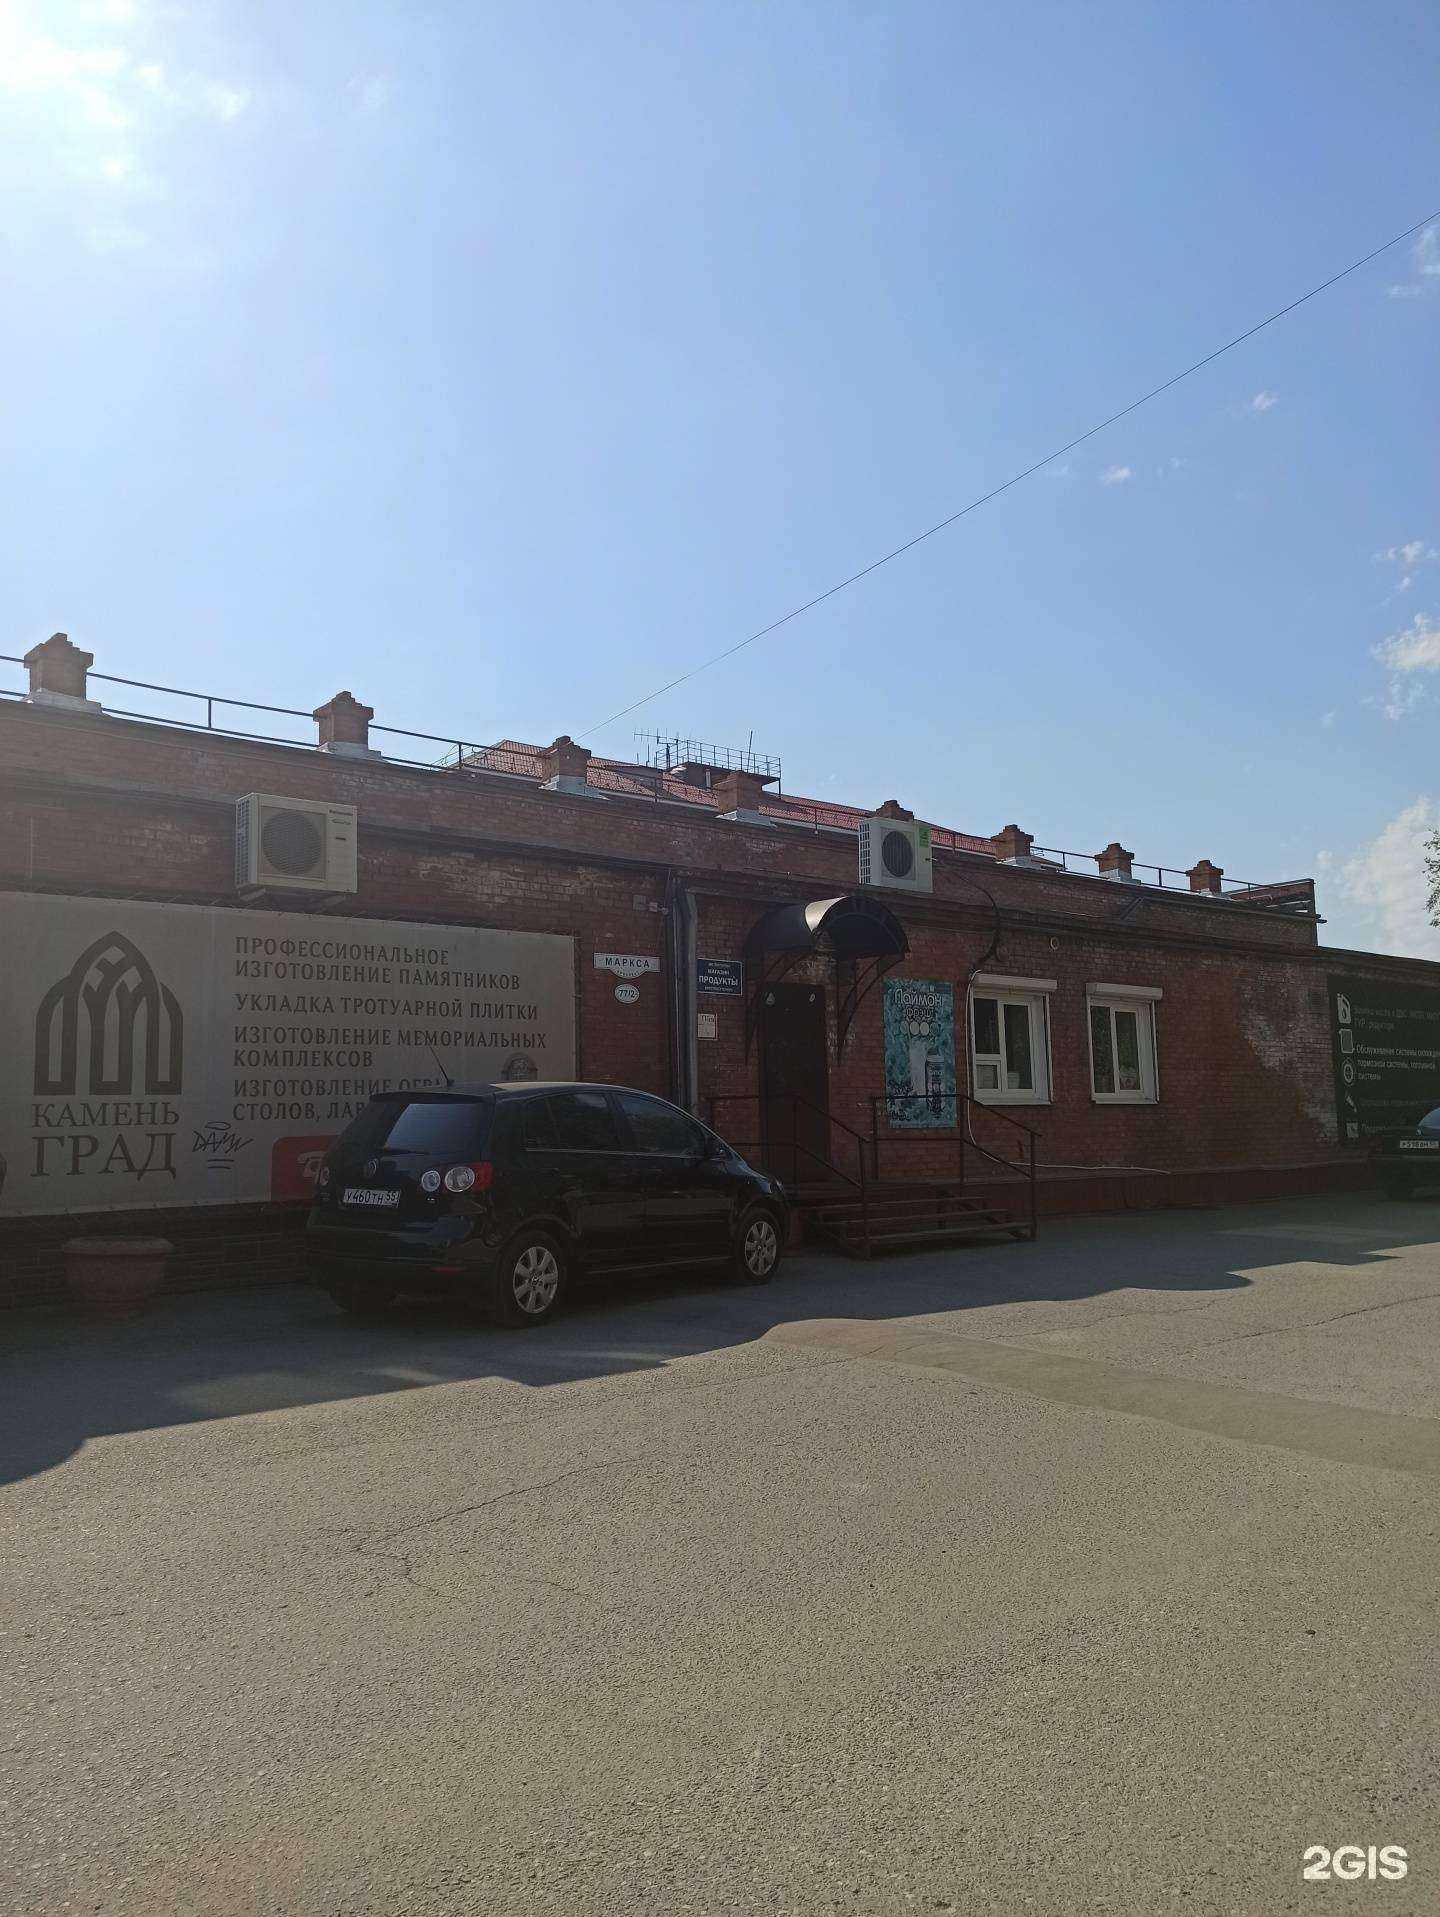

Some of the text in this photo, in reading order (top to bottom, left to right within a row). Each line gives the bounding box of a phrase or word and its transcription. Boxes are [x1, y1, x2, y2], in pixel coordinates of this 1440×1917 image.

[235, 936, 449, 965] ПРОФЕССИОНАЛЬНОЕ
[605, 957, 650, 969] МАРКСА
[235, 960, 520, 990] ИЗГОТОВЛЕНИЕ ПАМЯТНИКОВ
[698, 975, 738, 987] ПРОДУКТЫ
[236, 993, 537, 1021] УКЛАДКА ТРОТУАРНОЙ ПЛИТКИ
[234, 1026, 547, 1049] ИЗГОТОВЛЕНИЕ МЕМОРИАЛЬНЫХ
[233, 1049, 373, 1068] КОМПЛЕКСОВ
[234, 1078, 391, 1097] ИЗГОТОВЛЕНИЕ
[31, 1102, 180, 1127] КАМЕНЬ
[233, 1102, 321, 1122] СТОЛОВ,
[30, 1132, 177, 1181] ГРАД
